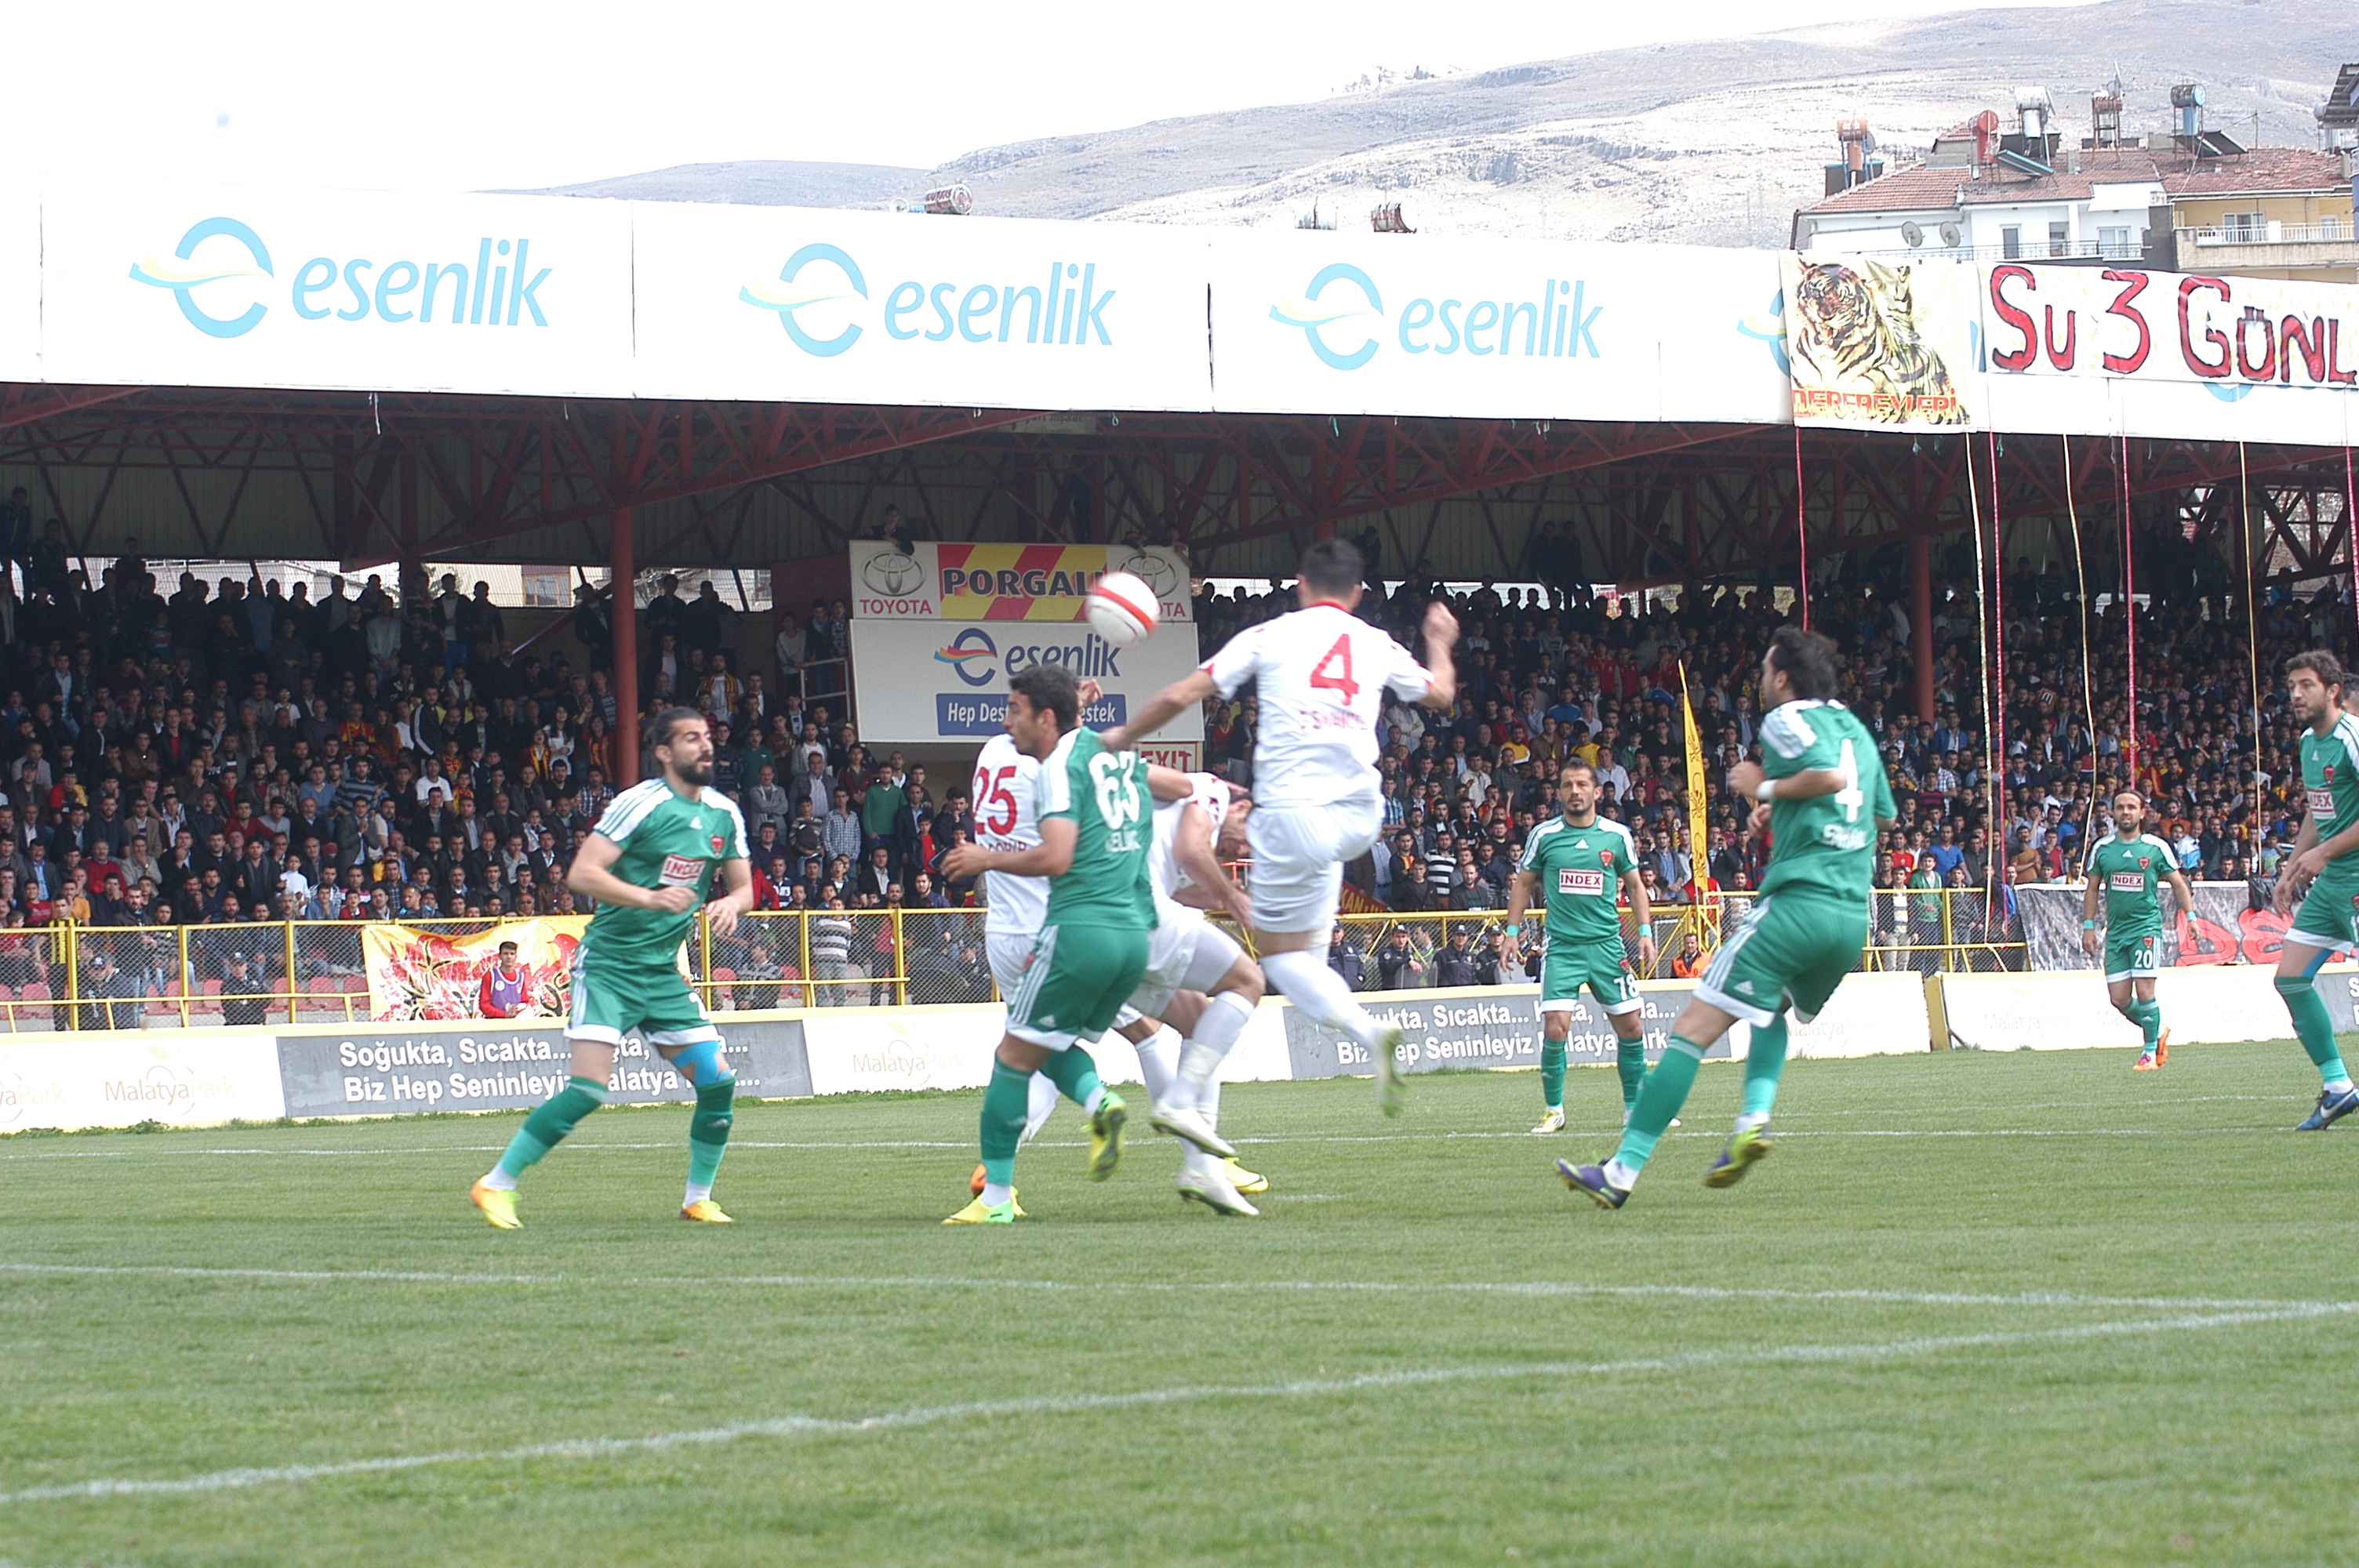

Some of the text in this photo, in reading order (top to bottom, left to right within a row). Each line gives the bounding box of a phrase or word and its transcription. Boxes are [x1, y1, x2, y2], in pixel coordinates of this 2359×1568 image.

[293, 238, 552, 326] esenlik
[885, 262, 1115, 345] esenlik
[1400, 280, 1602, 358] esenlik
[2102, 270, 2150, 374] 3
[943, 568, 1104, 597] PORGAL
[860, 599, 932, 614] TOYOTA
[1005, 633, 1121, 677] esenlik
[1309, 633, 1360, 706] 4
[947, 702, 1116, 728] Hep Dest estek
[1141, 750, 1192, 773] EXIT
[1834, 739, 1864, 823] 4
[972, 765, 1018, 836] 25
[1560, 873, 1601, 887] INDEX
[2134, 949, 2154, 969] 20
[339, 1040, 453, 1072] Soğukta,
[1394, 1043, 1421, 1066] ep
[1425, 1032, 1534, 1060] Seninleyiz
[343, 1076, 387, 1102] Biz
[391, 1075, 444, 1105] Hep
[607, 1066, 679, 1096] alatya
